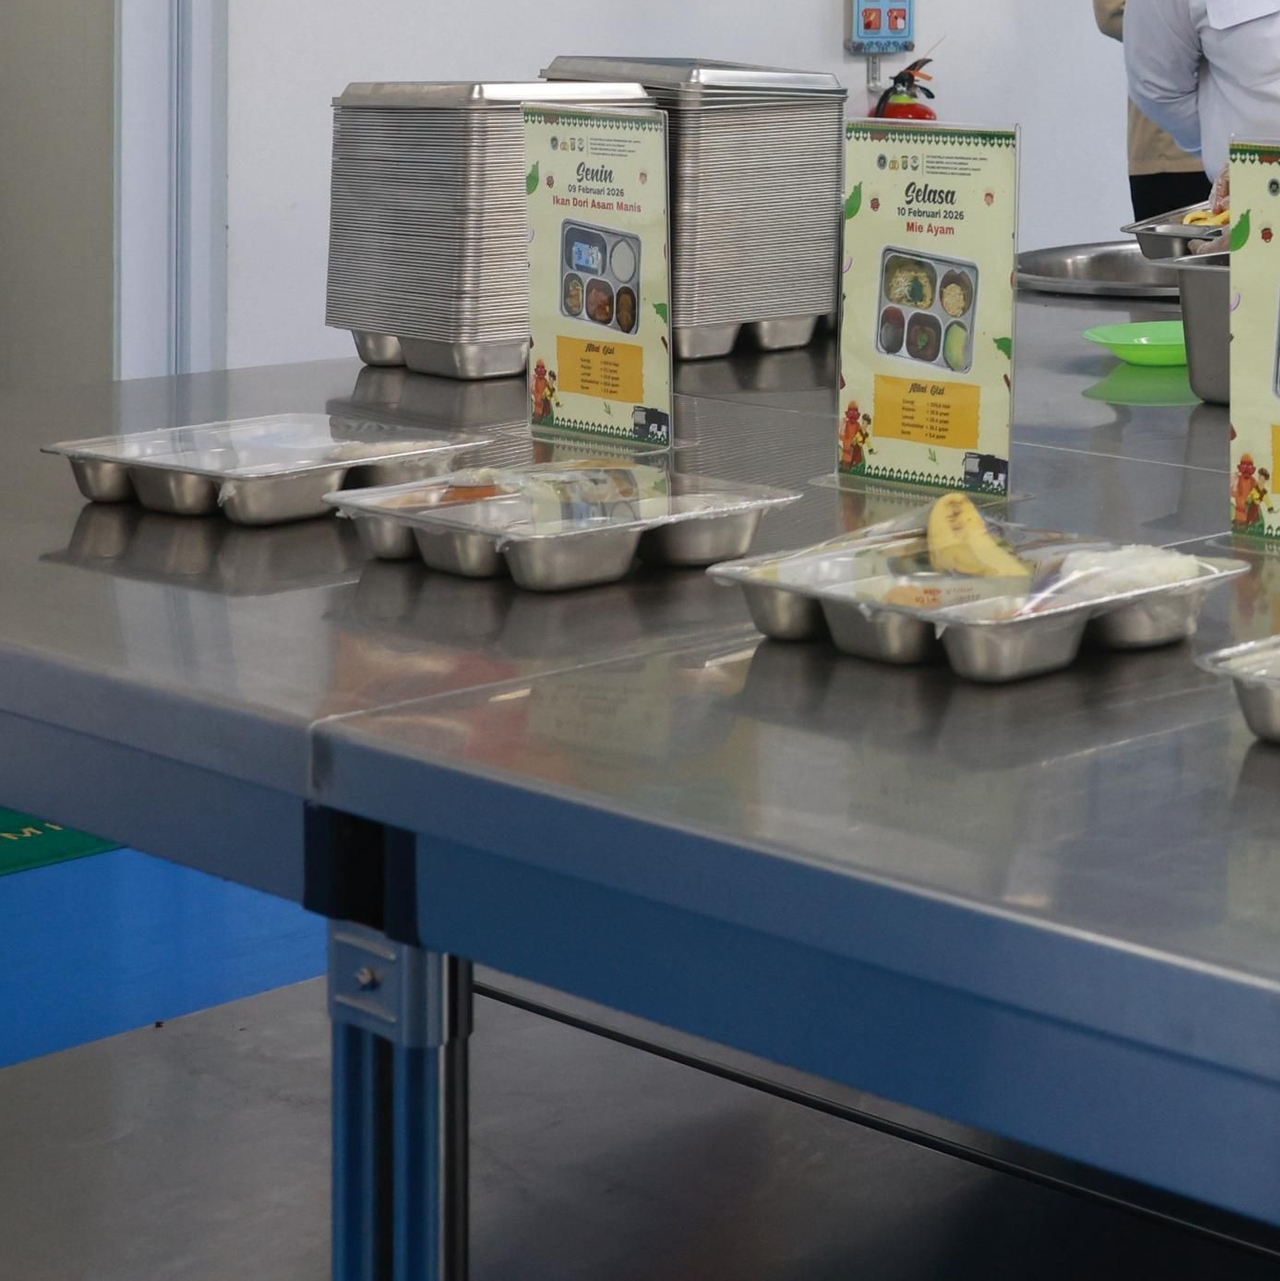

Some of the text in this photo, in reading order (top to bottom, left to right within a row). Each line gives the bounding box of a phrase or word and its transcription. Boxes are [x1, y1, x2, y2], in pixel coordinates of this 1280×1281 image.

[575, 160, 614, 185] Senin
[567, 184, 624, 197] 09 Februari 2026
[904, 181, 956, 205] Selasa
[553, 195, 641, 213] Ikan Dori Asam Manis
[897, 206, 964, 220] 10 Februari 2026
[906, 222, 955, 236] Mie Ayam
